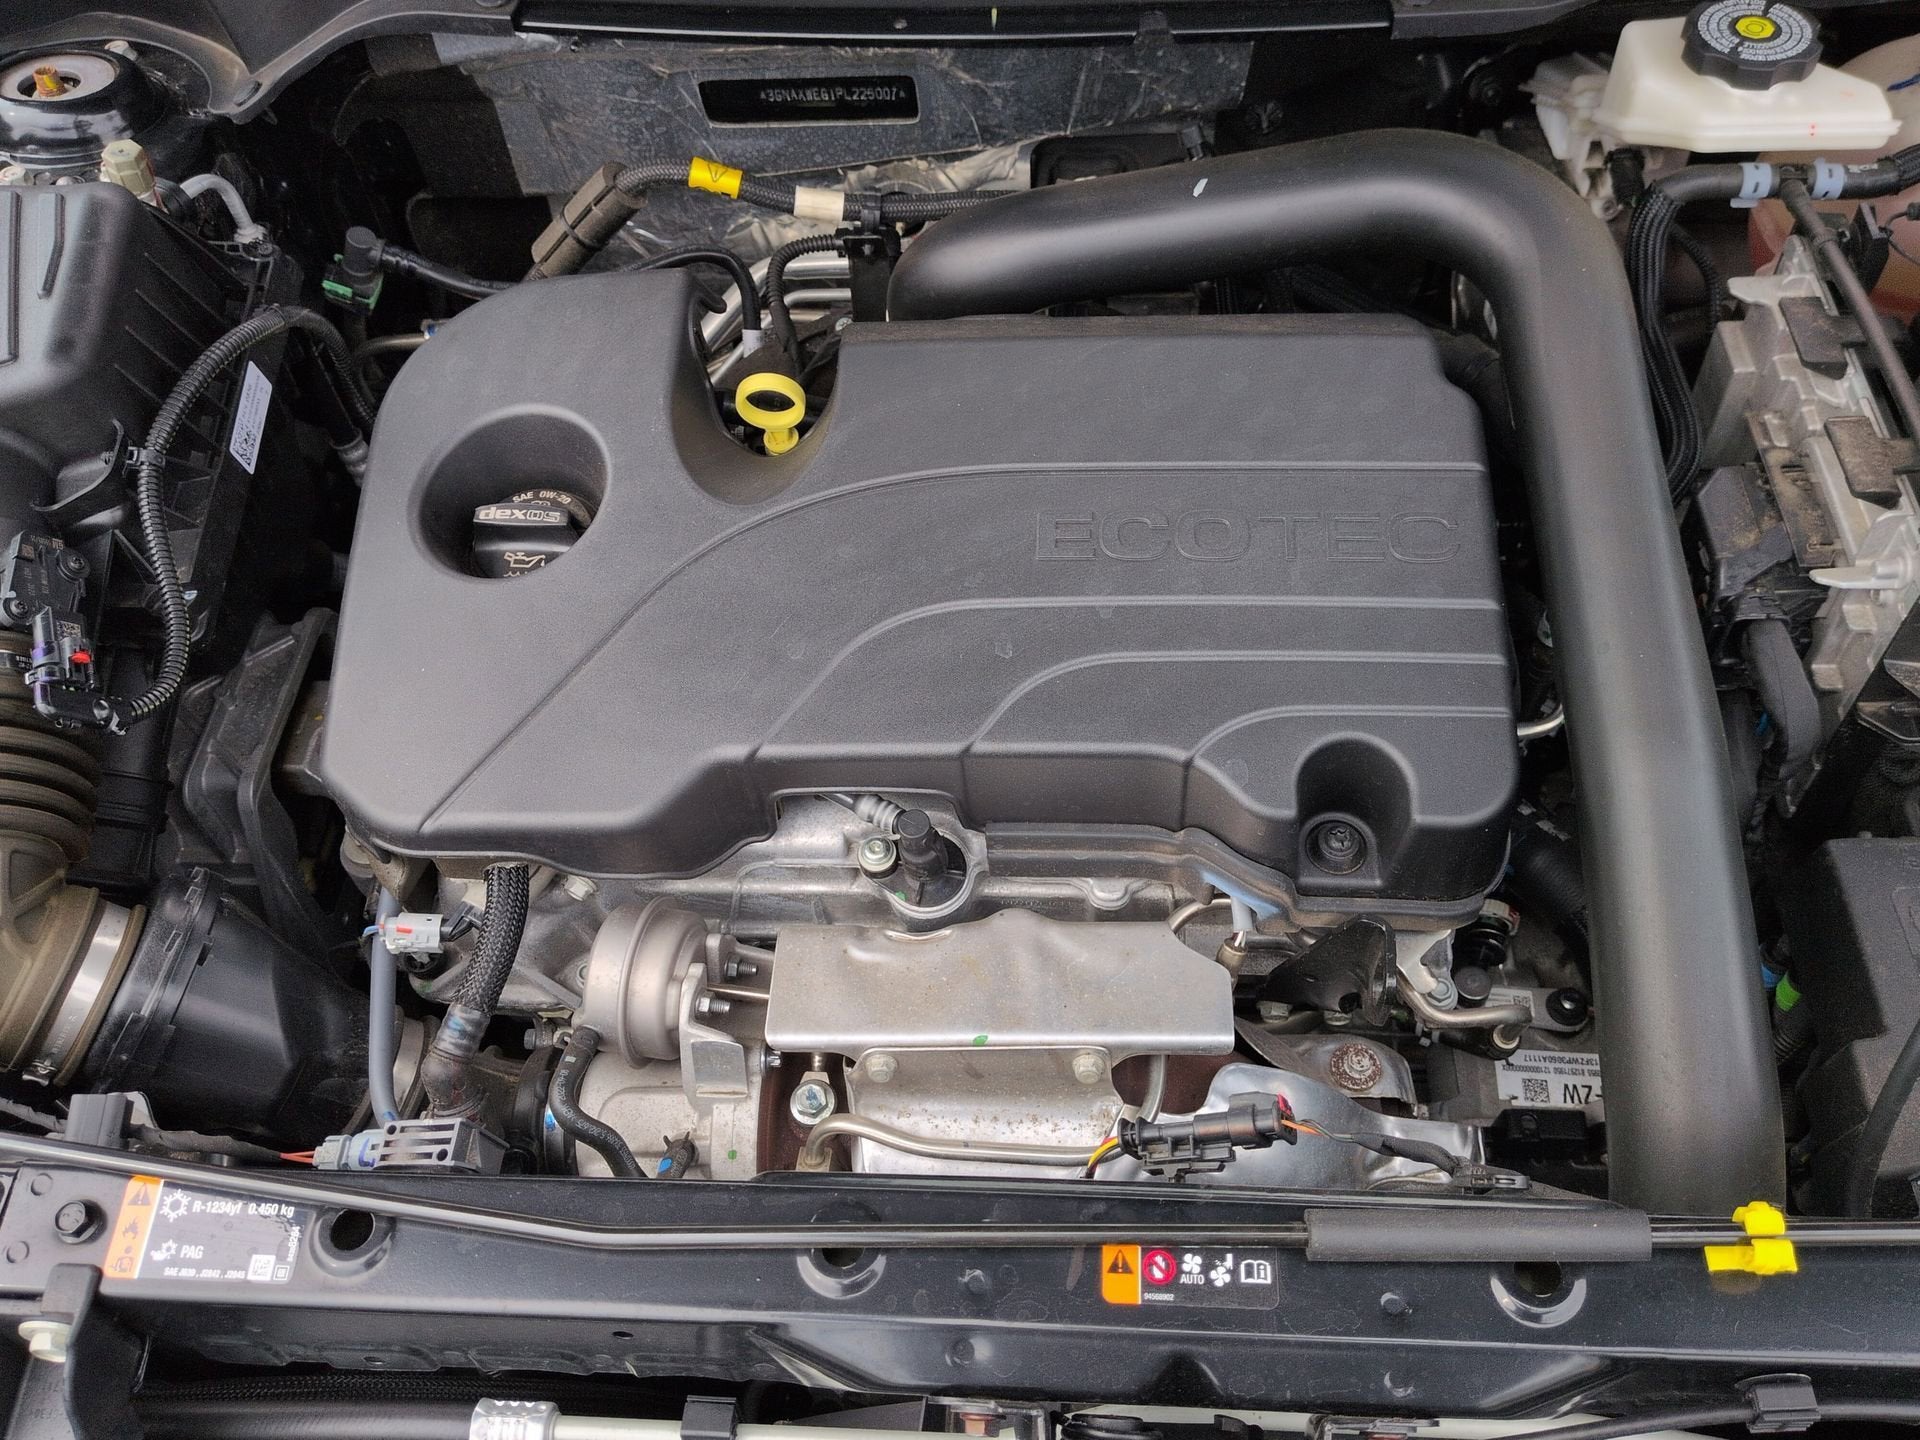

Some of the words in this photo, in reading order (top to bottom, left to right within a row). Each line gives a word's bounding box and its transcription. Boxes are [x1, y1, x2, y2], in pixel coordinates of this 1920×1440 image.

[512, 491, 534, 503] SAE
[539, 490, 572, 504] 0W-20
[478, 506, 561, 523] dexos
[1035, 510, 1460, 563] ECOTEC
[1563, 1083, 1592, 1104] ZW
[192, 1200, 242, 1216] R-1234yf
[248, 1203, 279, 1215] 0.450
[280, 1203, 295, 1217] kg
[180, 1245, 205, 1259] PAG
[1179, 1273, 1205, 1285] AUTO
